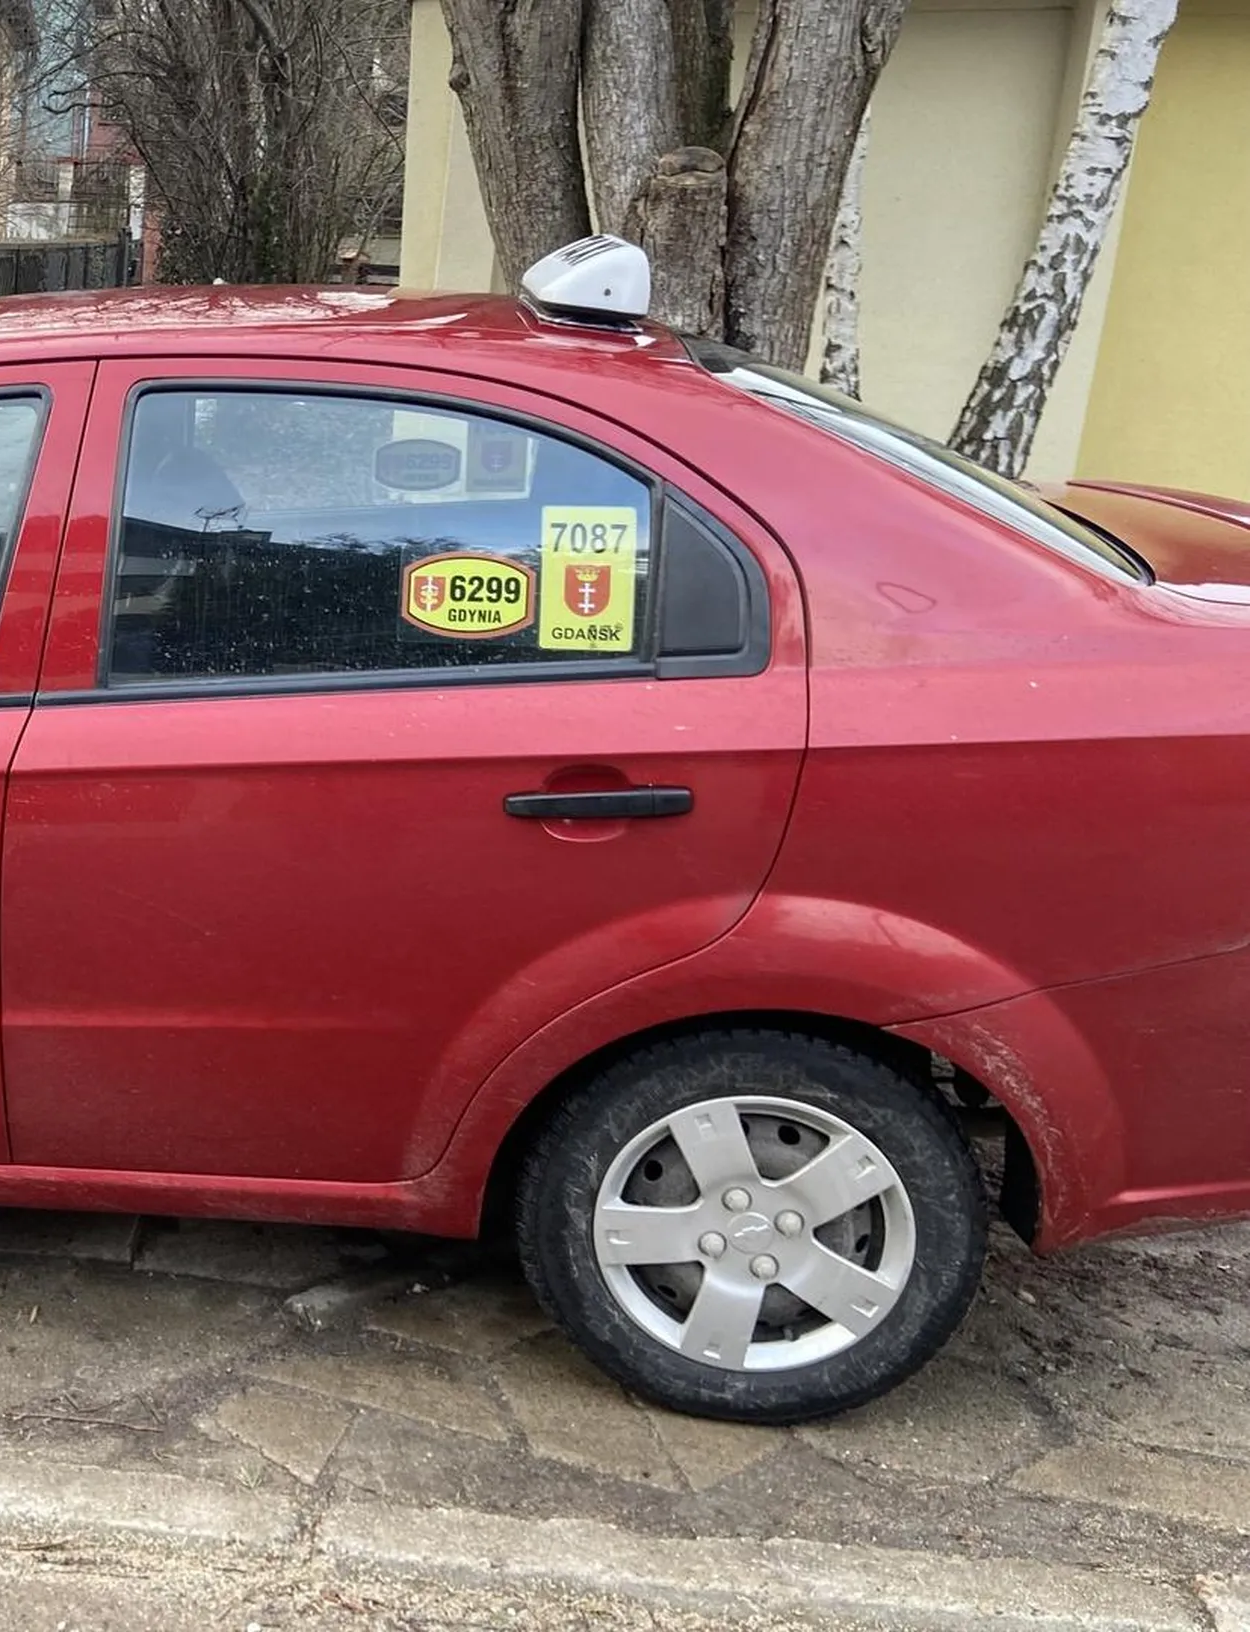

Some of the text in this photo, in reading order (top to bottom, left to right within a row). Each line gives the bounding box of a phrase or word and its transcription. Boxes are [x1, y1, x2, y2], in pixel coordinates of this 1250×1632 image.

[550, 522, 628, 554] 7087
[450, 575, 521, 604] 6299
[447, 608, 502, 624] GDYNIA
